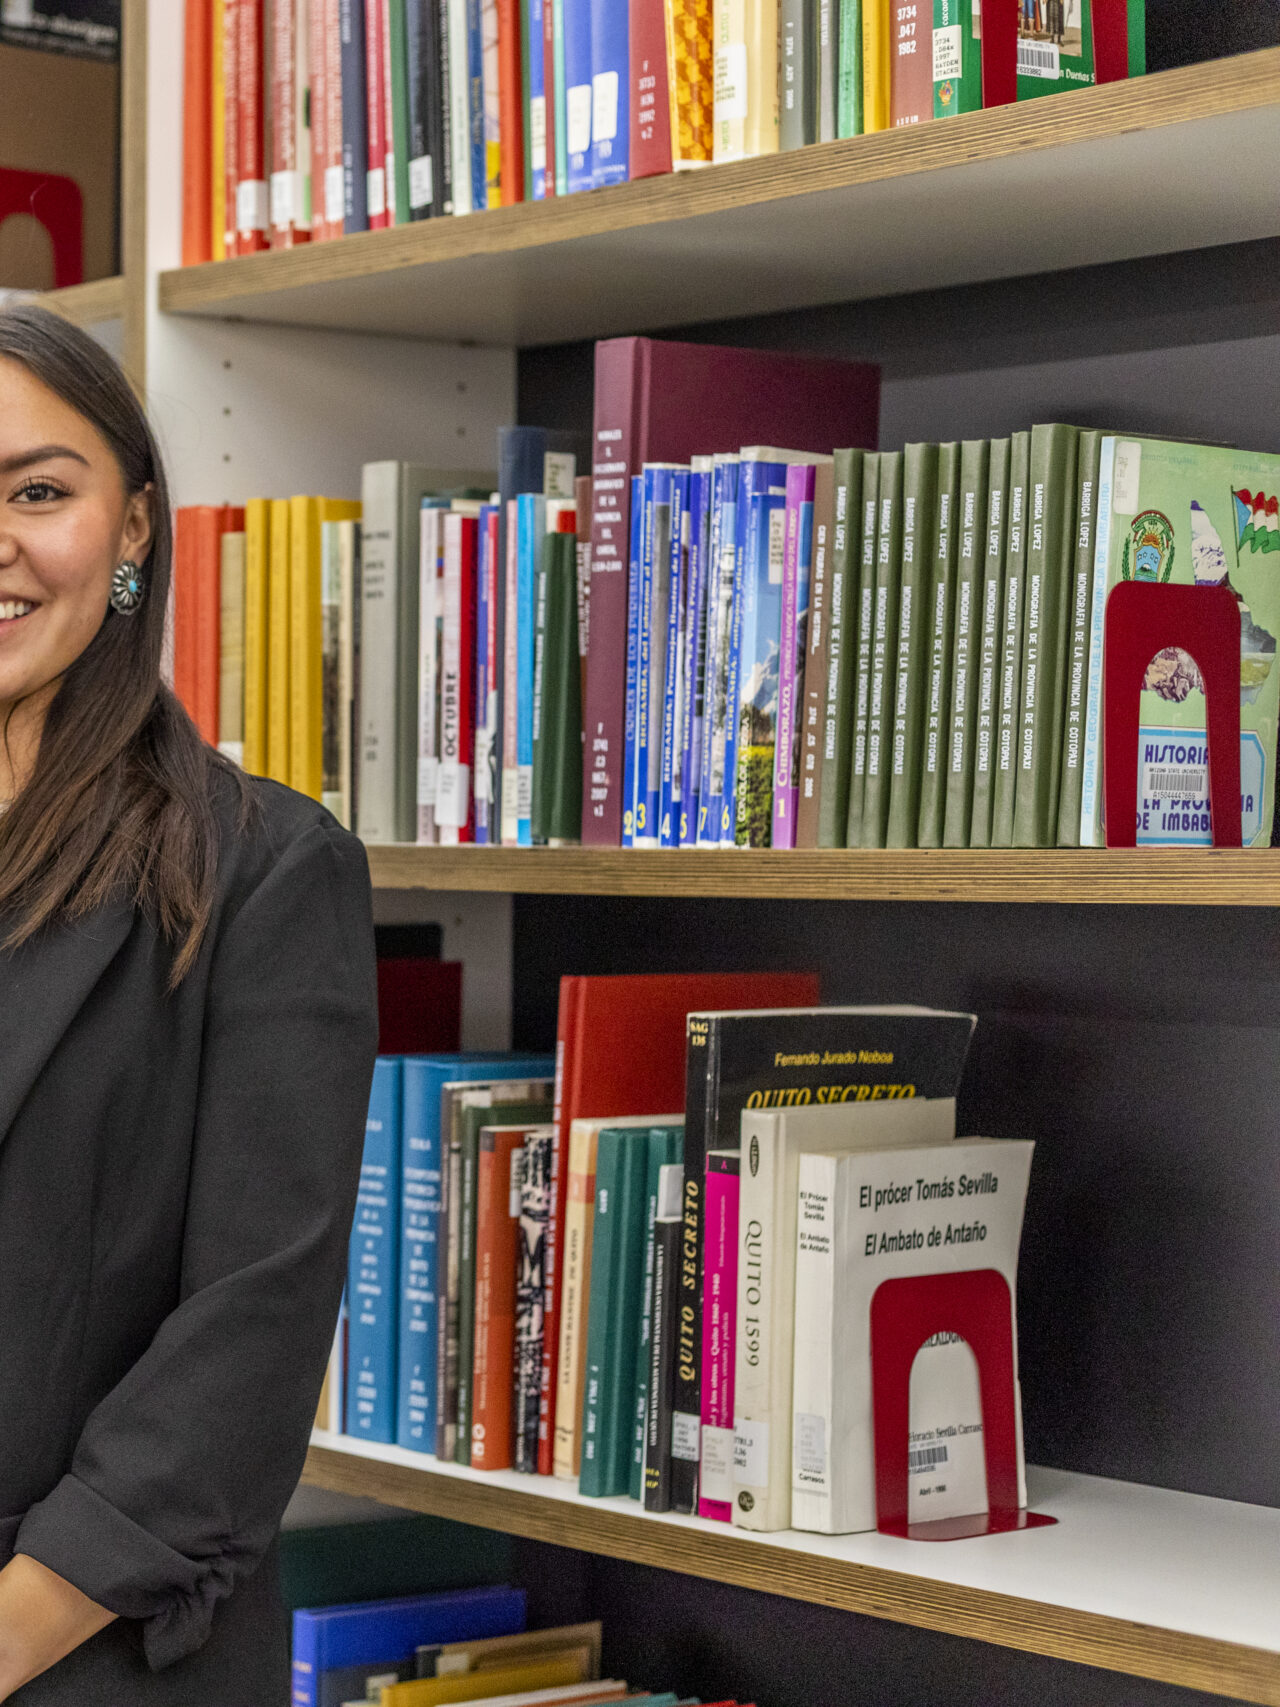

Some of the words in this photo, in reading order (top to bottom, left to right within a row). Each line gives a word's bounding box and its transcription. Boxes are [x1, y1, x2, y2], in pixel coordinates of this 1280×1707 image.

[897, 5, 917, 21] 3734
[935, 59, 959, 69] HAYDEN
[935, 67, 959, 78] STACKS
[1065, 67, 1090, 83] Dueñas
[965, 493, 974, 527] BARRIGA
[991, 491, 1001, 525] BARRIGA
[1013, 488, 1022, 522] BARRIGA
[1035, 484, 1043, 519] BARRIGA
[1082, 482, 1092, 517] BARRIGA
[1097, 482, 1109, 542] IMBABURA
[672, 488, 681, 539] Colonia
[963, 532, 972, 557] LOPEZ
[989, 530, 998, 555] LOPEZ
[1011, 527, 1020, 552] LOPEZ
[1033, 524, 1041, 549] LOPEZ
[1079, 522, 1089, 547] LOPEZ
[671, 557, 678, 573] de
[1096, 550, 1106, 562] DE
[960, 582, 970, 634] MONOGRAFIA
[986, 580, 996, 632] MONOGRAFIA
[1008, 578, 1017, 630] MONOGRAFIA
[1030, 576, 1039, 628] MONOGRAFIA
[1076, 573, 1086, 626] MONOGRAFIA
[1093, 568, 1105, 630] PROVINCIA
[959, 639, 967, 649] DE
[985, 638, 993, 647] DE
[1007, 635, 1014, 645] DE
[1029, 633, 1037, 643] DE
[1075, 632, 1083, 641] DE
[1092, 636, 1101, 648] LA
[665, 627, 675, 694] Personajes
[958, 654, 966, 664] LA
[984, 653, 992, 663] LA
[1006, 651, 1014, 661] LA
[1029, 649, 1036, 659] LA
[1075, 647, 1083, 657] LA
[1091, 652, 1100, 667] DE
[956, 669, 965, 712] PROVINCIA
[982, 668, 992, 711] PROVINCIA
[1004, 666, 1013, 709] PROVINCIA
[1026, 665, 1035, 708] PROVINCIA
[1071, 663, 1082, 706] PROVINCIA
[445, 672, 457, 757] OCTUBRE
[1003, 714, 1011, 724] DE
[1025, 713, 1033, 723] DE
[1070, 711, 1079, 722] DE
[1087, 674, 1099, 741] GEOGRAFIA
[955, 717, 963, 727] DE
[981, 716, 989, 726] DE
[777, 683, 792, 788] CHIMBORAZO,
[1068, 727, 1078, 767] COTOPAXI
[953, 732, 963, 771] COTOPAXI
[979, 731, 989, 771] COTOPAXI
[1001, 730, 1010, 769] COTOPAXI
[1023, 729, 1032, 769] COTOPAXI
[1083, 759, 1094, 814] HISTORIA
[637, 803, 646, 829] 3
[700, 807, 708, 831] 7
[721, 805, 730, 830] 6
[778, 798, 786, 818] 1
[624, 810, 633, 836] 2
[662, 813, 671, 839] 4
[680, 813, 687, 839] 5
[774, 1052, 820, 1067] Fernando
[821, 1051, 856, 1065] Jurado
[857, 1050, 894, 1065] Noboa
[747, 1087, 811, 1109] QUITO
[816, 1084, 916, 1104] SECRETO
[800, 1191, 807, 1199] El
[859, 1186, 872, 1209] El
[874, 1181, 913, 1213] prócer
[915, 1176, 955, 1201] Tomás
[958, 1172, 999, 1197] Sevilla
[804, 1211, 825, 1222] Sevilla
[683, 1180, 699, 1290] SECRETO
[800, 1232, 807, 1240] El
[807, 1233, 829, 1244] Ambato
[864, 1234, 877, 1257] El
[878, 1229, 924, 1255] Ambato
[927, 1226, 941, 1247] de
[943, 1220, 987, 1245] Antaño
[745, 1220, 762, 1305] QUITO
[679, 1306, 695, 1381] QUITO
[710, 1326, 720, 1355] Quito
[746, 1317, 760, 1366] 1599
[936, 1425, 957, 1438] Sevilla
[799, 1473, 825, 1484] Carrasco
